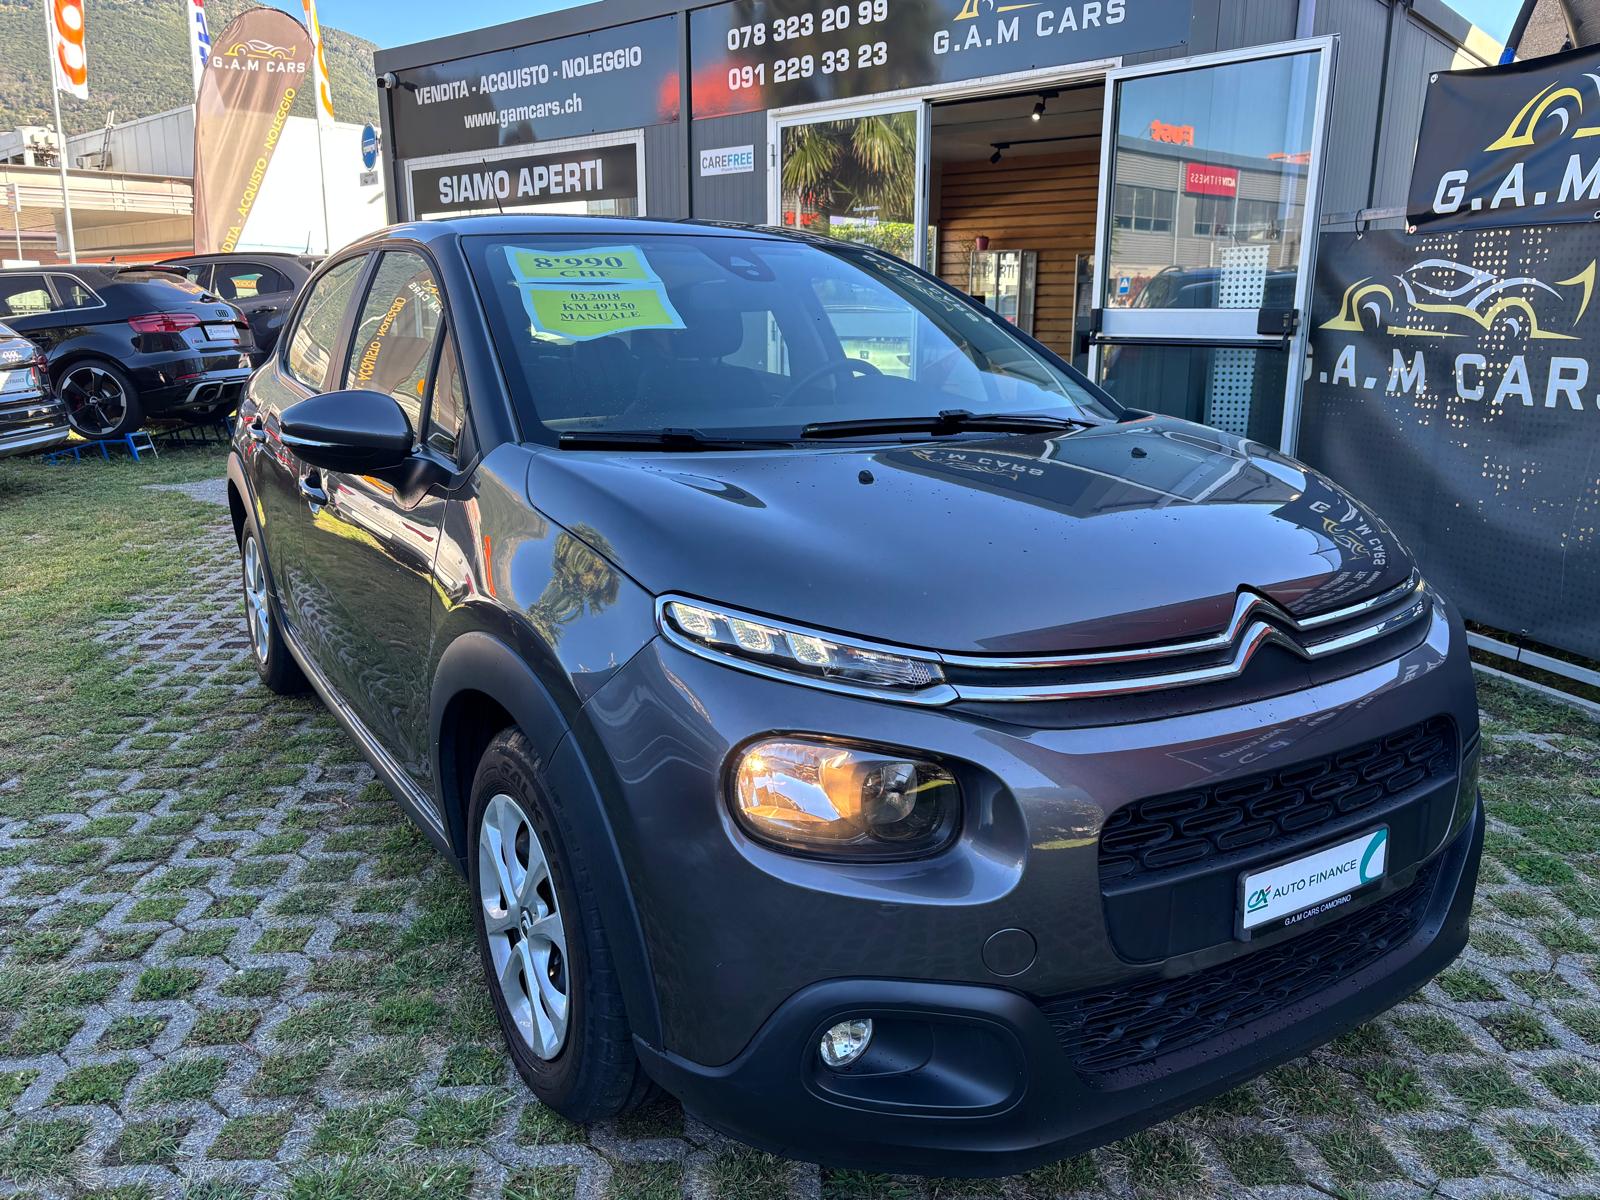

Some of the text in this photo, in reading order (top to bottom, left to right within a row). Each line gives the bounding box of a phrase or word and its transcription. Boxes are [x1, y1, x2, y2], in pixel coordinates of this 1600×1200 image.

[727, 0, 889, 51] 078 323 20 99
[933, 0, 1126, 55] G.A.M CARS
[212, 56, 306, 73] G.A.M CARS
[415, 79, 469, 106] VENDITA
[479, 63, 549, 96] ACQUISTO
[562, 45, 642, 80] NOLEGGIO
[728, 41, 889, 91] 091 229 33 23
[464, 93, 583, 129] www.gamcars.ch
[237, 157, 267, 218] ACQUISTO
[263, 87, 296, 150] NOLEGGIO
[701, 152, 753, 169] CAREFREE
[439, 158, 603, 204] SIAMO APERTI
[533, 255, 624, 268] 8'990
[559, 270, 613, 278] CHF
[562, 302, 635, 311] KM 49'150
[570, 292, 621, 301] 03.2018
[560, 311, 641, 321] MANUALE
[1455, 353, 1600, 410] CAR
[1273, 879, 1306, 899] AUTO
[1309, 859, 1358, 887] FINANCE
[1302, 906, 1320, 919] CARS
[1320, 894, 1352, 913] CAMORINO
